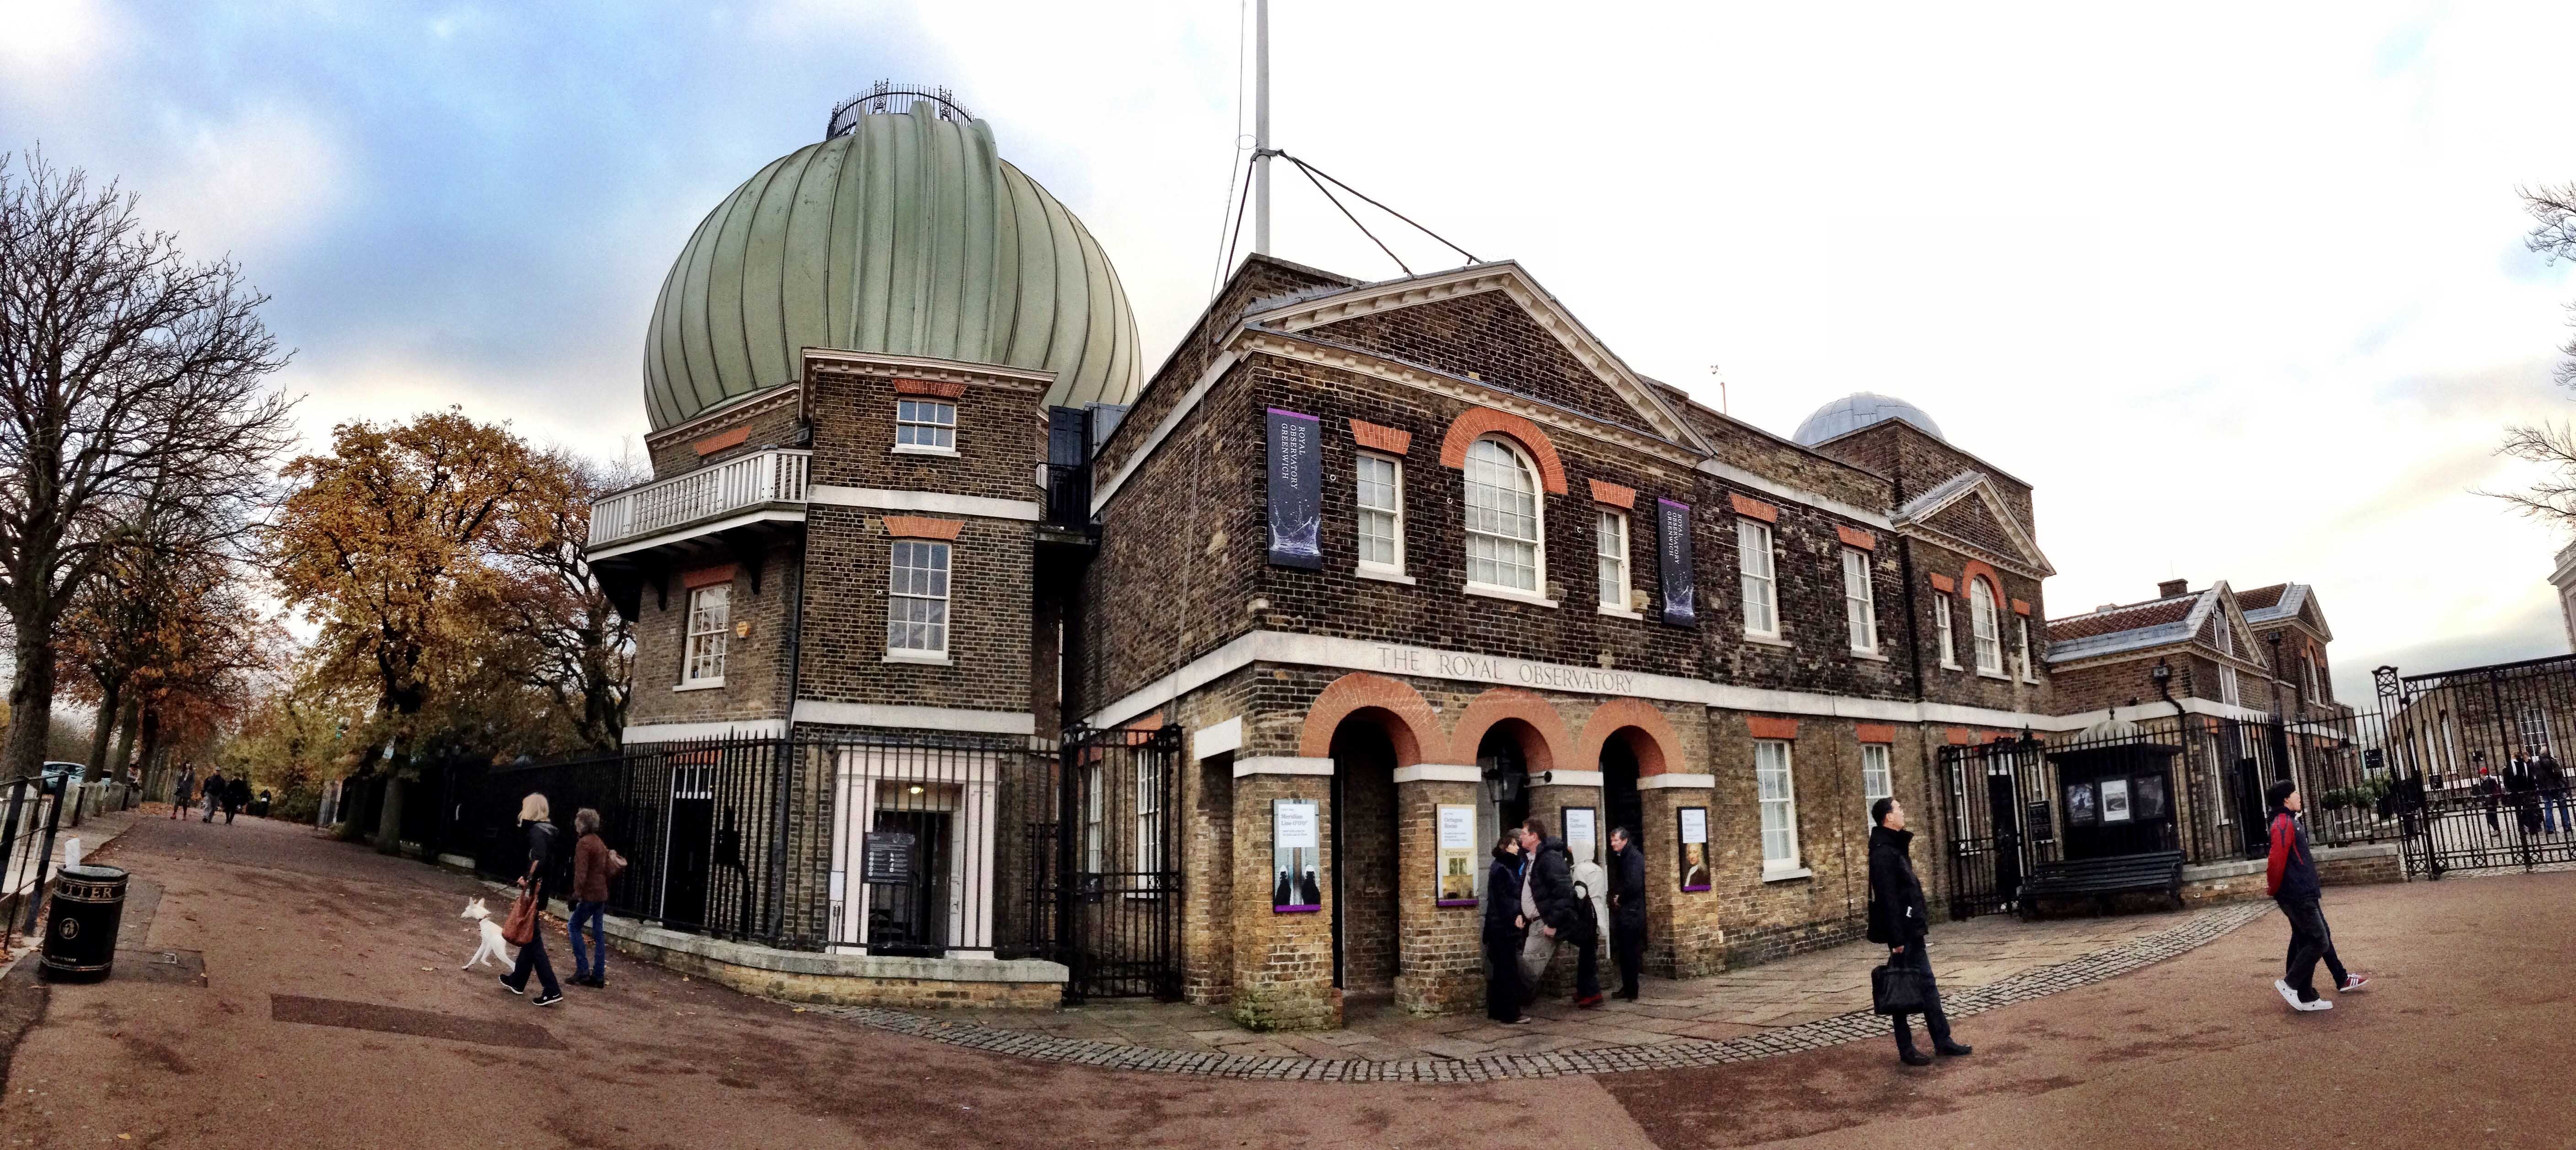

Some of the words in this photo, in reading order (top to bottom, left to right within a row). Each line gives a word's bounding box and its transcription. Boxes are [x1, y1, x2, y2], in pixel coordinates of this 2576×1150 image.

[1377, 647, 1420, 671] THE
[1440, 655, 1503, 680] ROYAL
[1519, 664, 1635, 693] OBSERVATORY
